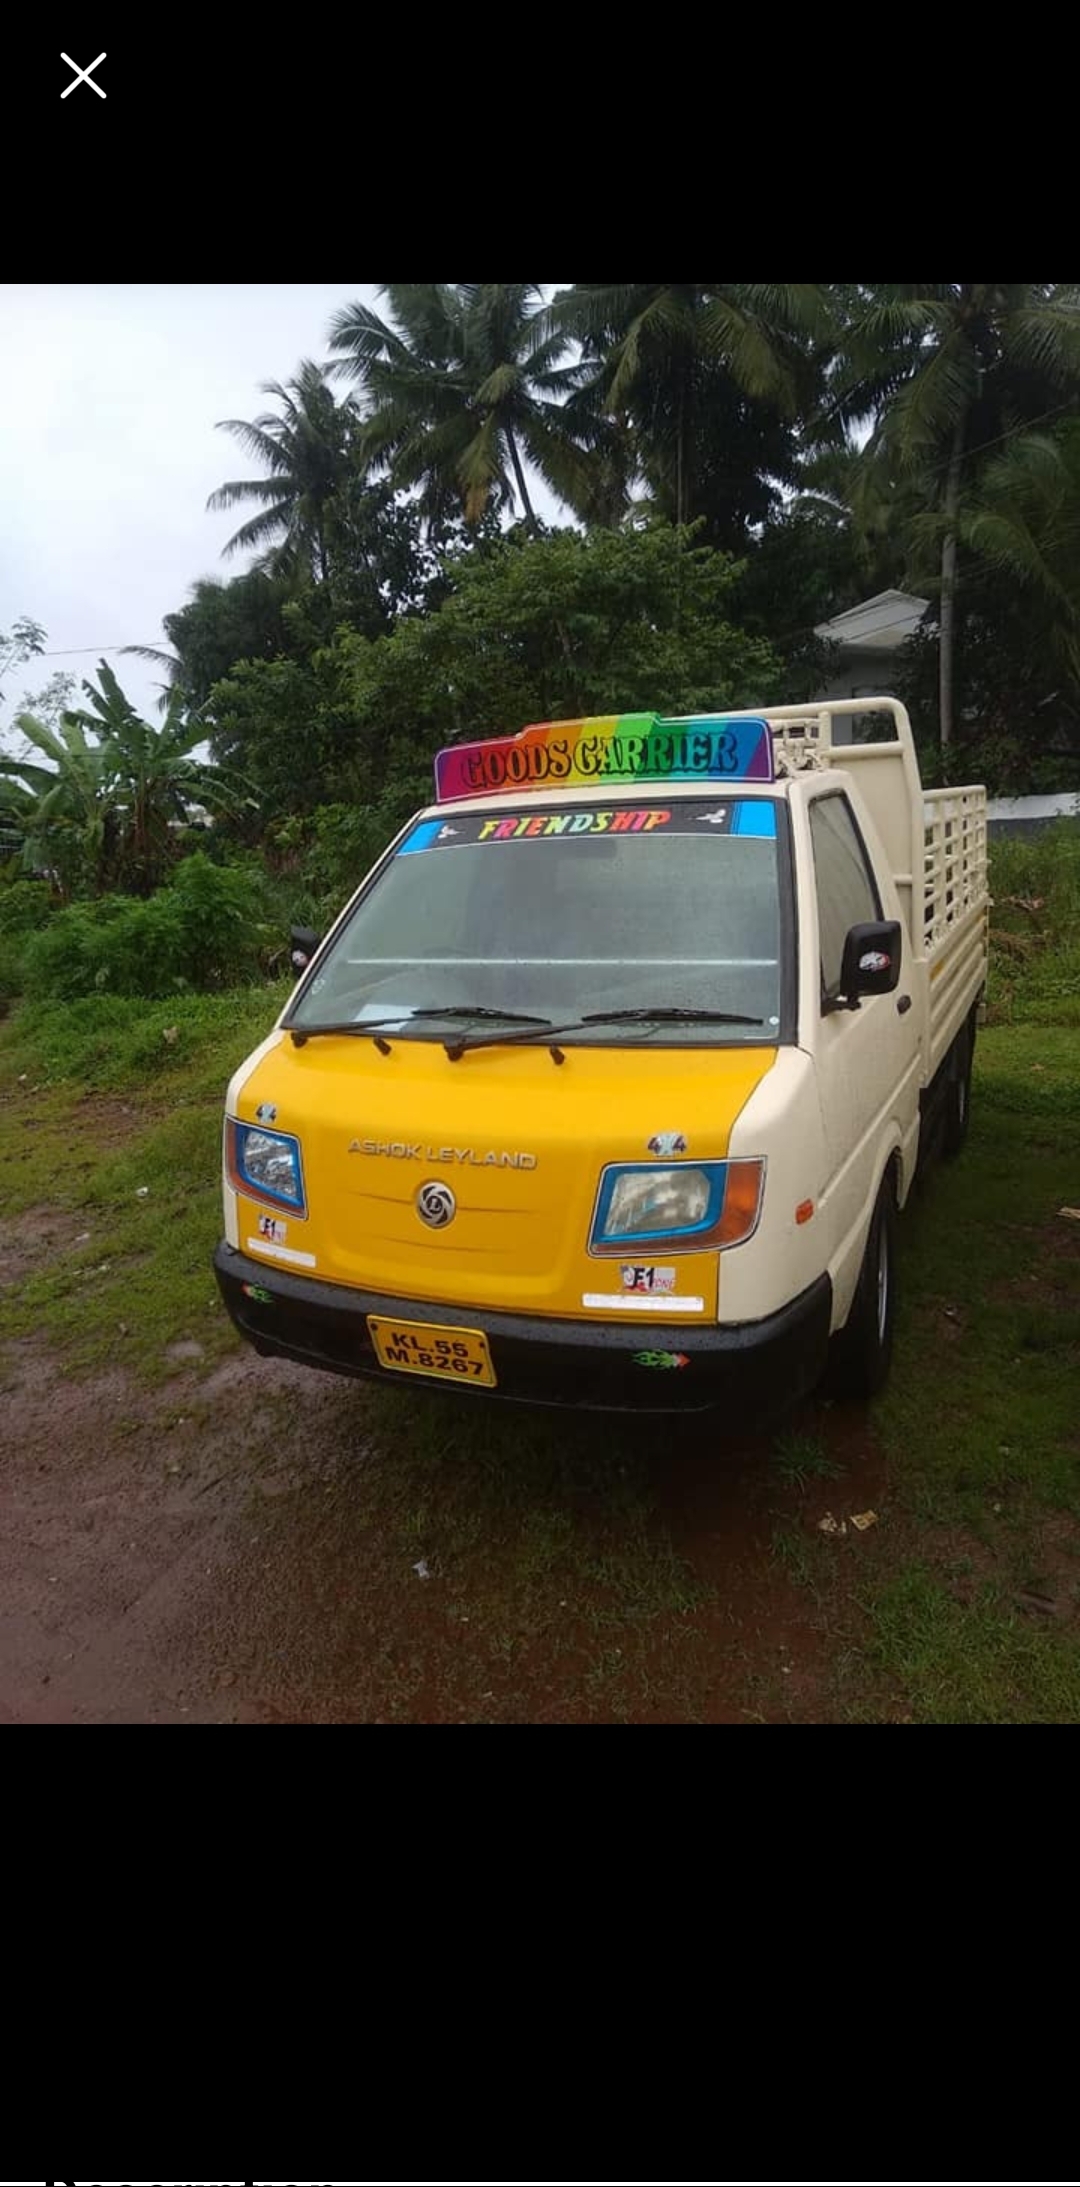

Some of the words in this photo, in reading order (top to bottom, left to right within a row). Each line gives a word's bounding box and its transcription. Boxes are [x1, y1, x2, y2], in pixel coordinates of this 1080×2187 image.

[461, 739, 571, 788] GOODS
[478, 809, 671, 840] FRIENDSHIP
[348, 1138, 421, 1160] ASHOK
[426, 1146, 538, 1170] LEYLAND
[385, 1346, 484, 1375] M.8267
[391, 1332, 469, 1358] KL.55
